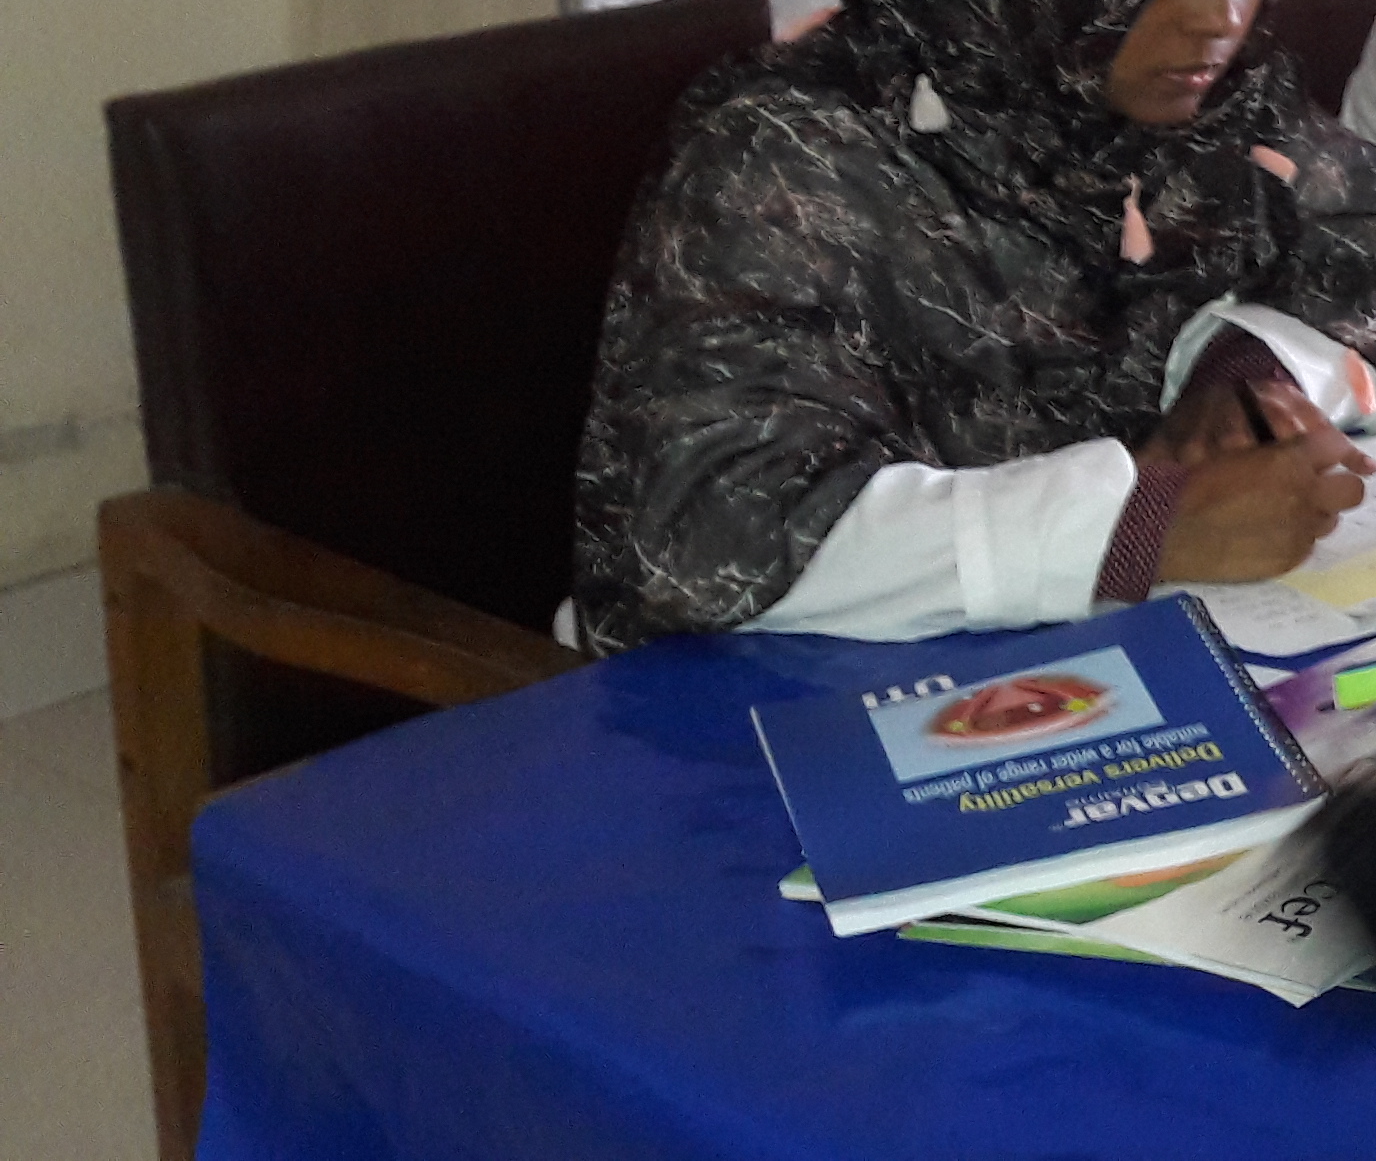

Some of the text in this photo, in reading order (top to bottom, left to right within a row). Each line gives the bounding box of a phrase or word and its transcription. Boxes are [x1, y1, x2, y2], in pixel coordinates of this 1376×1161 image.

[861, 674, 956, 710] UTI
[1050, 749, 1100, 770] wider
[1103, 741, 1224, 780] Delivers
[1116, 737, 1145, 758] for
[975, 769, 994, 790] of
[998, 758, 1048, 782] range
[903, 771, 974, 804] patients
[959, 769, 1101, 813] versatility
